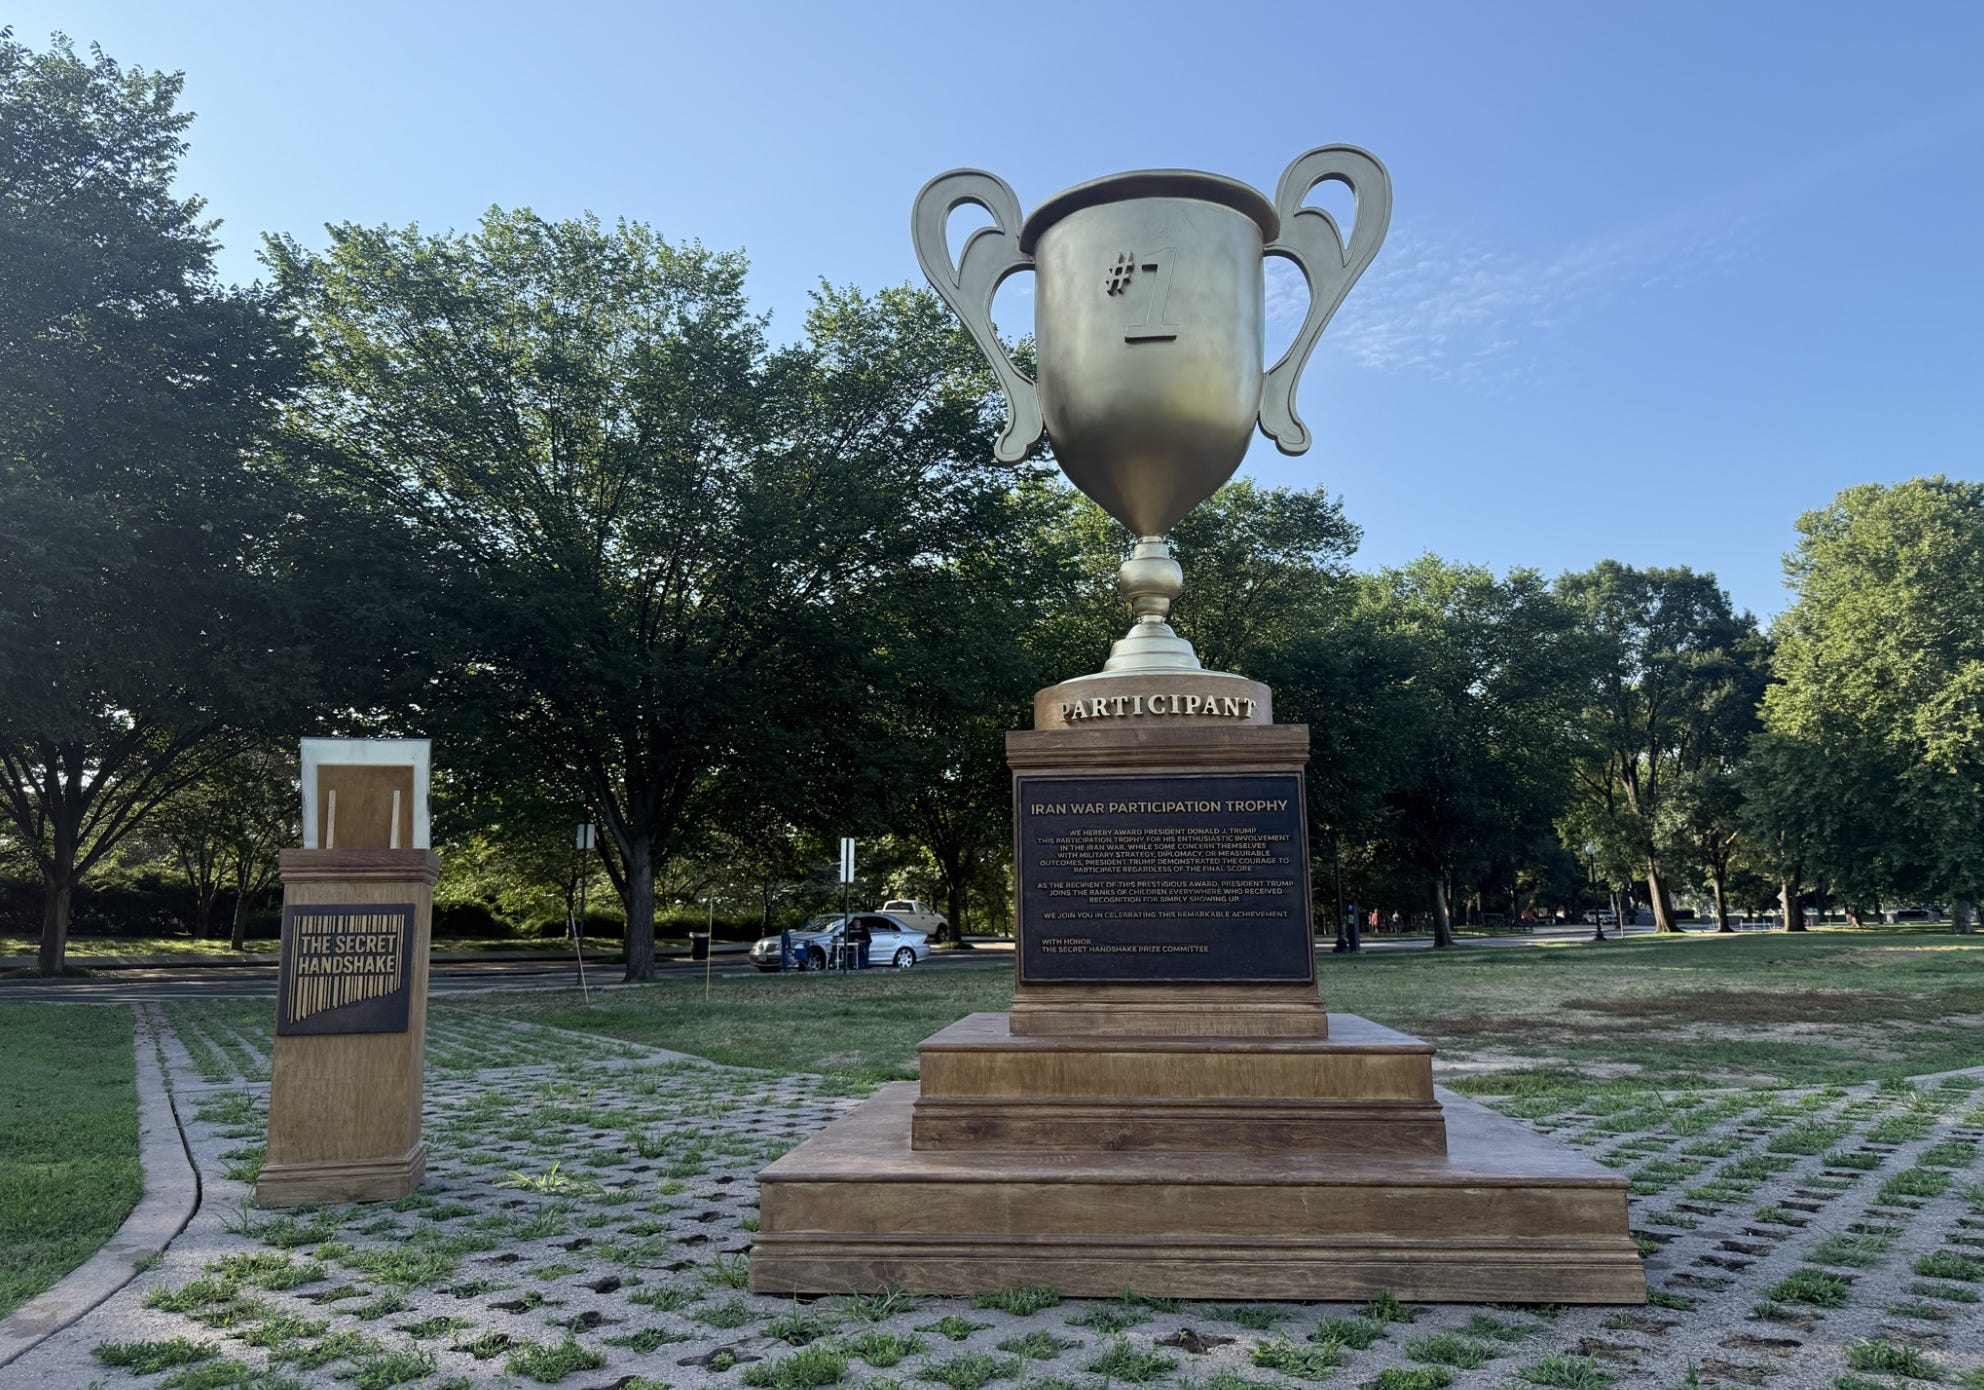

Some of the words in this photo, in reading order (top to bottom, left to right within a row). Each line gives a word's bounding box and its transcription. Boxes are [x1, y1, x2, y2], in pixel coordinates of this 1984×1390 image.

[1104, 246, 1183, 344] #1
[1058, 694, 1256, 722] PARTICIPANT
[1031, 804, 1066, 814] IRAN
[1071, 803, 1104, 814] WAR
[1109, 801, 1221, 813] PARTICIPATION
[1226, 800, 1287, 812] TROPHY
[302, 937, 330, 954] THE
[336, 935, 396, 953] SECRET
[299, 956, 395, 974] HANDSHAKE
